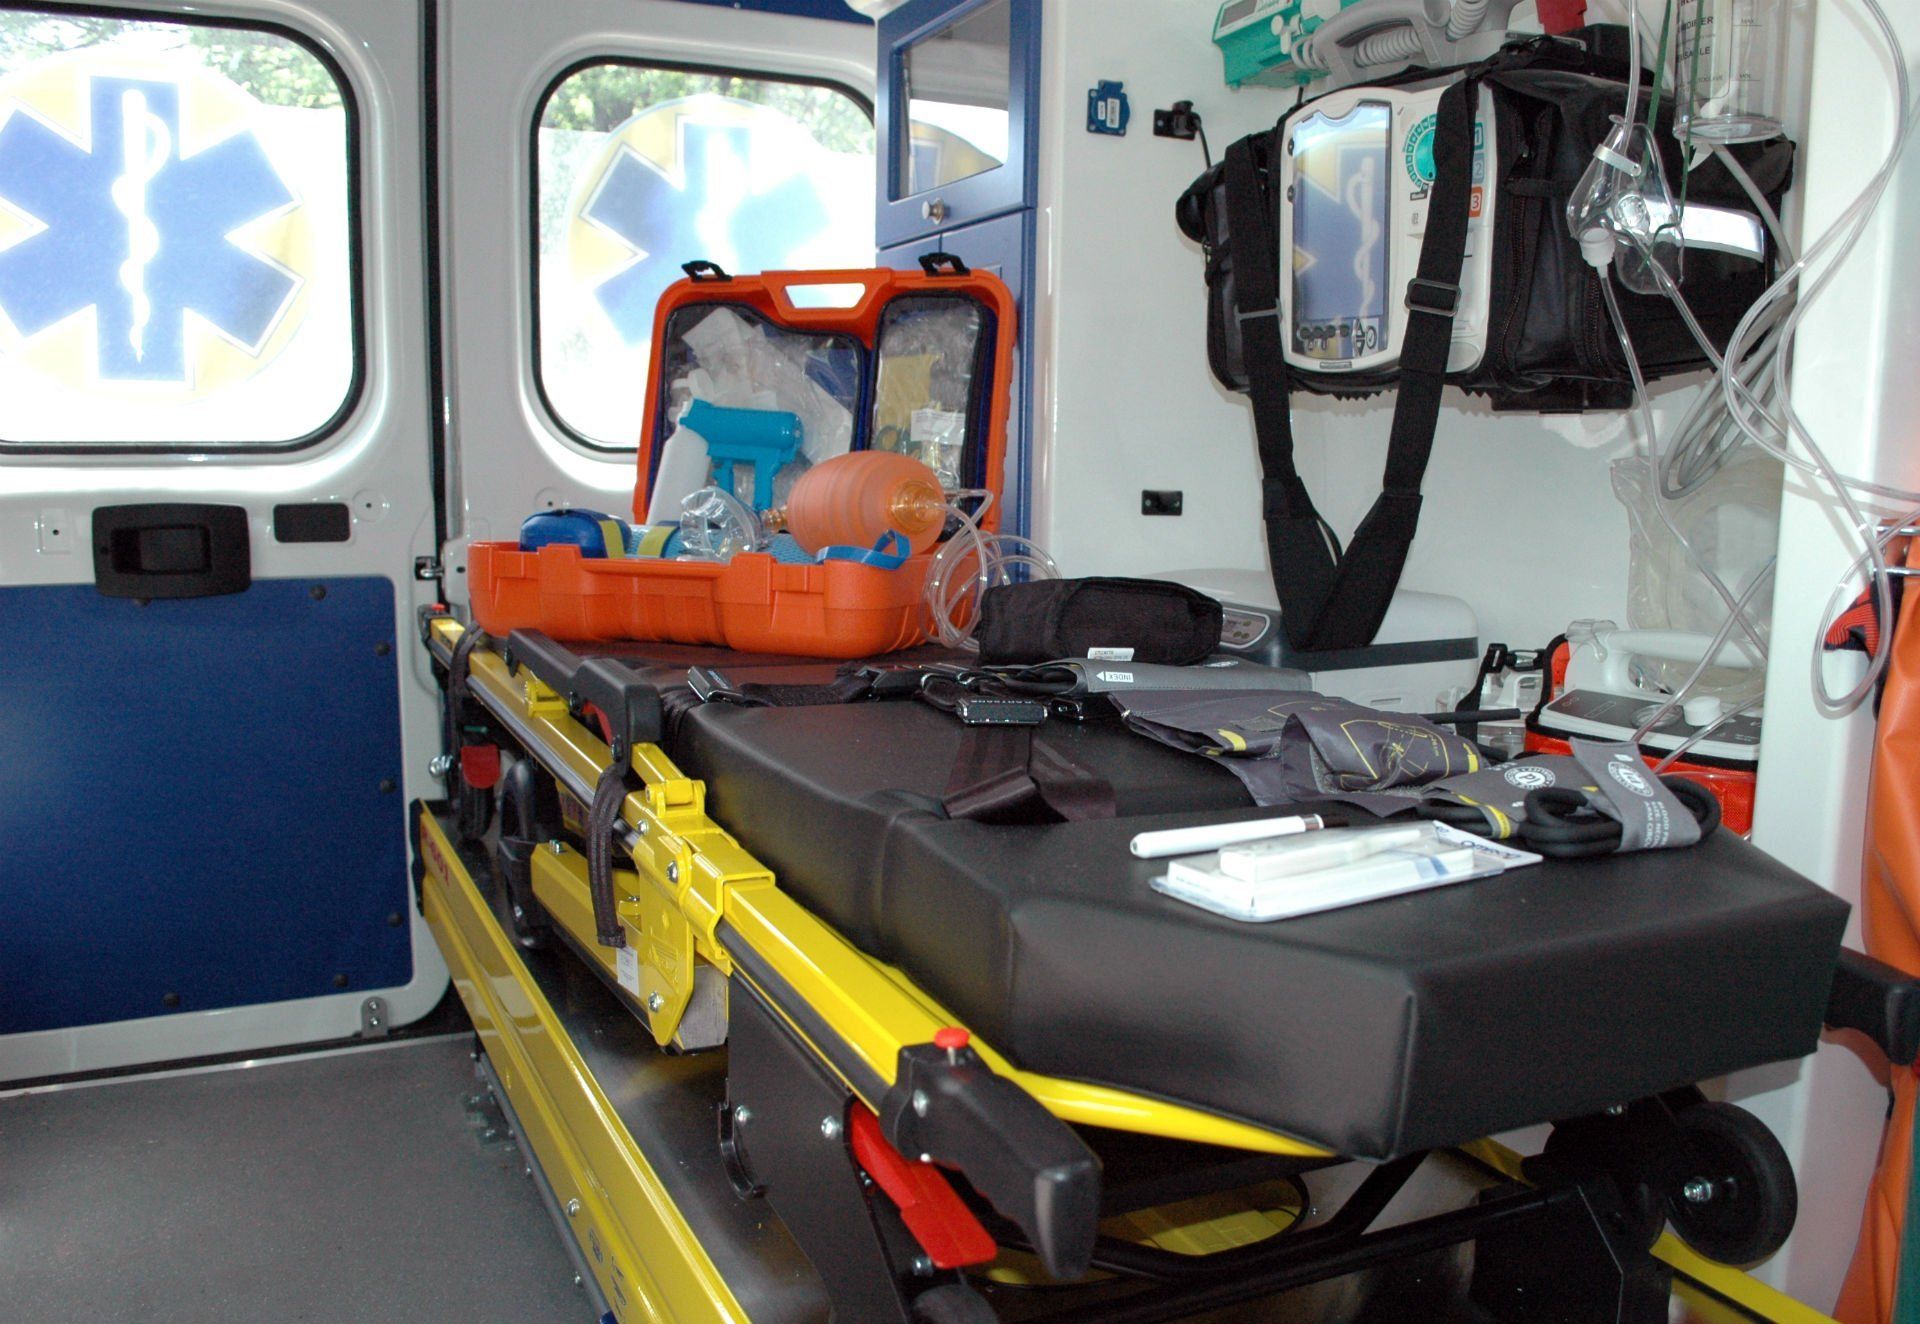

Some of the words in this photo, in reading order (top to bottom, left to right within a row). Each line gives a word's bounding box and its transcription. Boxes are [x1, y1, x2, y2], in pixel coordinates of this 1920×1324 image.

[1475, 163, 1482, 176] 2
[1472, 195, 1480, 209] 3
[1109, 673, 1132, 682] INDEX
